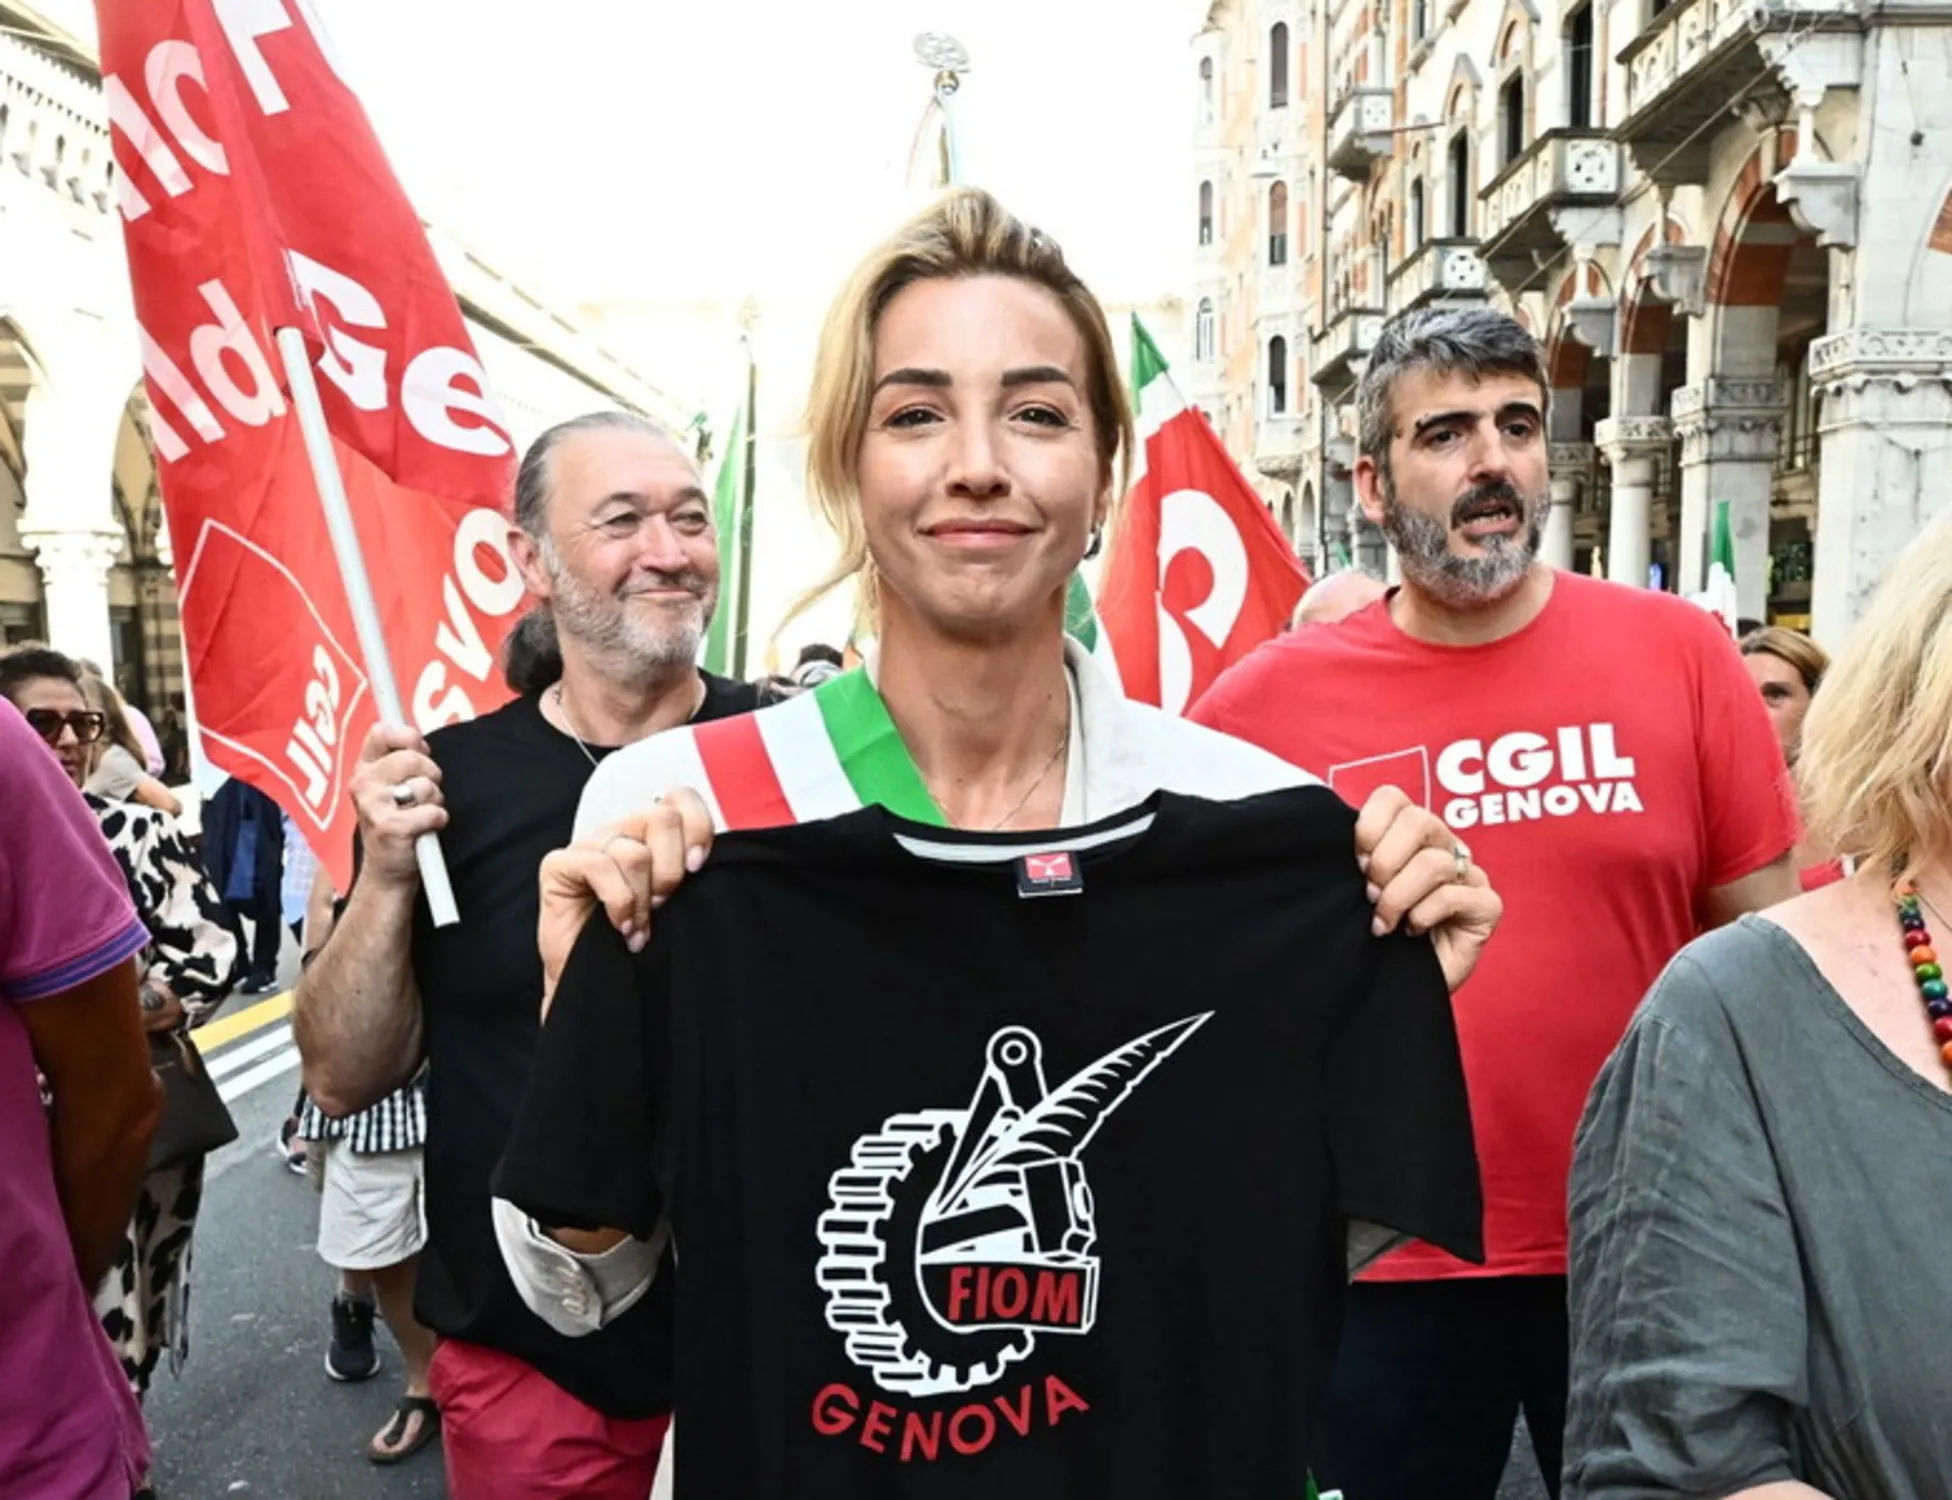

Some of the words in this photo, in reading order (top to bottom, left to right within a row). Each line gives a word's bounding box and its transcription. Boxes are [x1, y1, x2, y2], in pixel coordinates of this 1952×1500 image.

[1436, 723, 1635, 794] CGIL
[1444, 782, 1644, 829] GENOVA
[948, 1266, 1079, 1325] FIOM
[811, 1375, 1090, 1462] GENOVA
